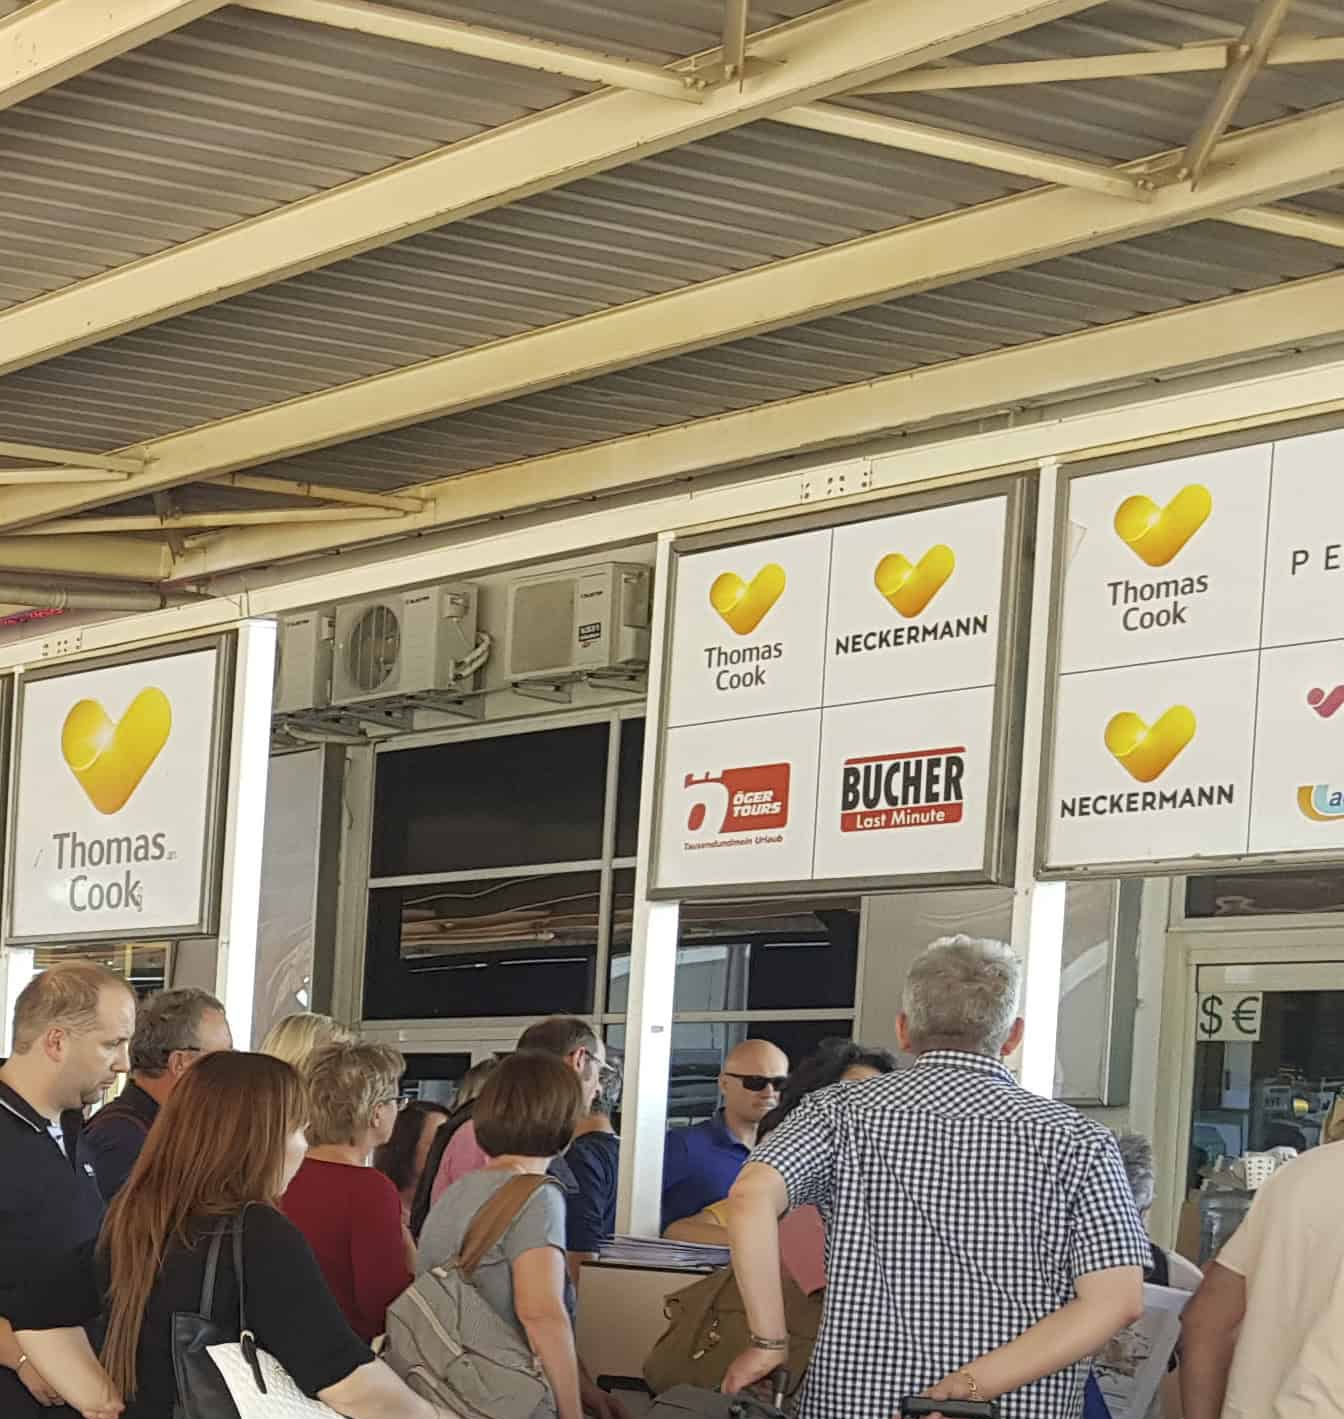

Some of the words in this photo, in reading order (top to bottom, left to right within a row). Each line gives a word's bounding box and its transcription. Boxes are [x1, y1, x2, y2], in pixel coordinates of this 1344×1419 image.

[1107, 572, 1209, 607] Thomas
[1122, 600, 1187, 633] Cook
[834, 614, 989, 656] NECKERMANN
[704, 640, 784, 671] Thomas
[715, 667, 767, 692] Cook
[732, 789, 774, 805] ÖGER
[840, 755, 965, 813] BUCHER
[1059, 783, 1235, 819] NECKERMANN
[732, 801, 782, 817] TOURS
[855, 811, 889, 830] Last
[891, 807, 946, 827] Minute
[53, 831, 167, 870] Thomas
[69, 870, 140, 913] Cook
[1198, 994, 1223, 1039] $
[1231, 995, 1261, 1034] €
